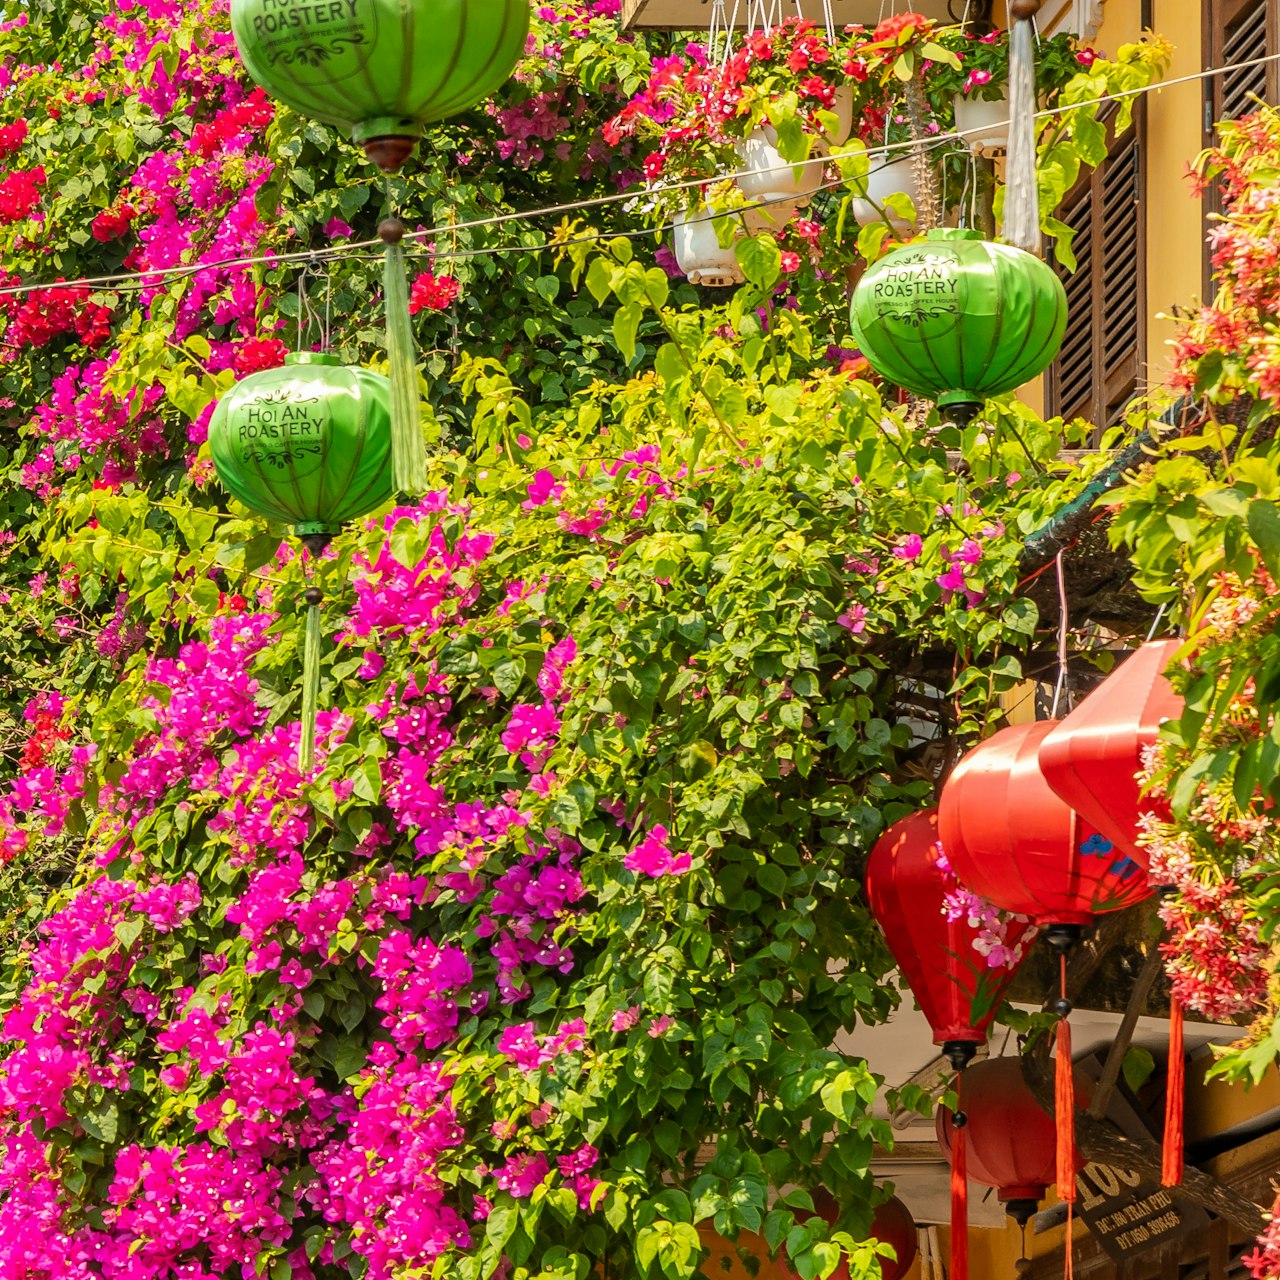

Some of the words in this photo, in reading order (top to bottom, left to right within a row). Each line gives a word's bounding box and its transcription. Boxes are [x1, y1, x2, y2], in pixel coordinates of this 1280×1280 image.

[886, 269, 913, 283] HOI
[916, 267, 943, 280] AN
[874, 279, 958, 299] ROASTERY
[248, 408, 277, 423] HOI
[282, 406, 307, 421] AN
[238, 418, 323, 443] ROASTERY
